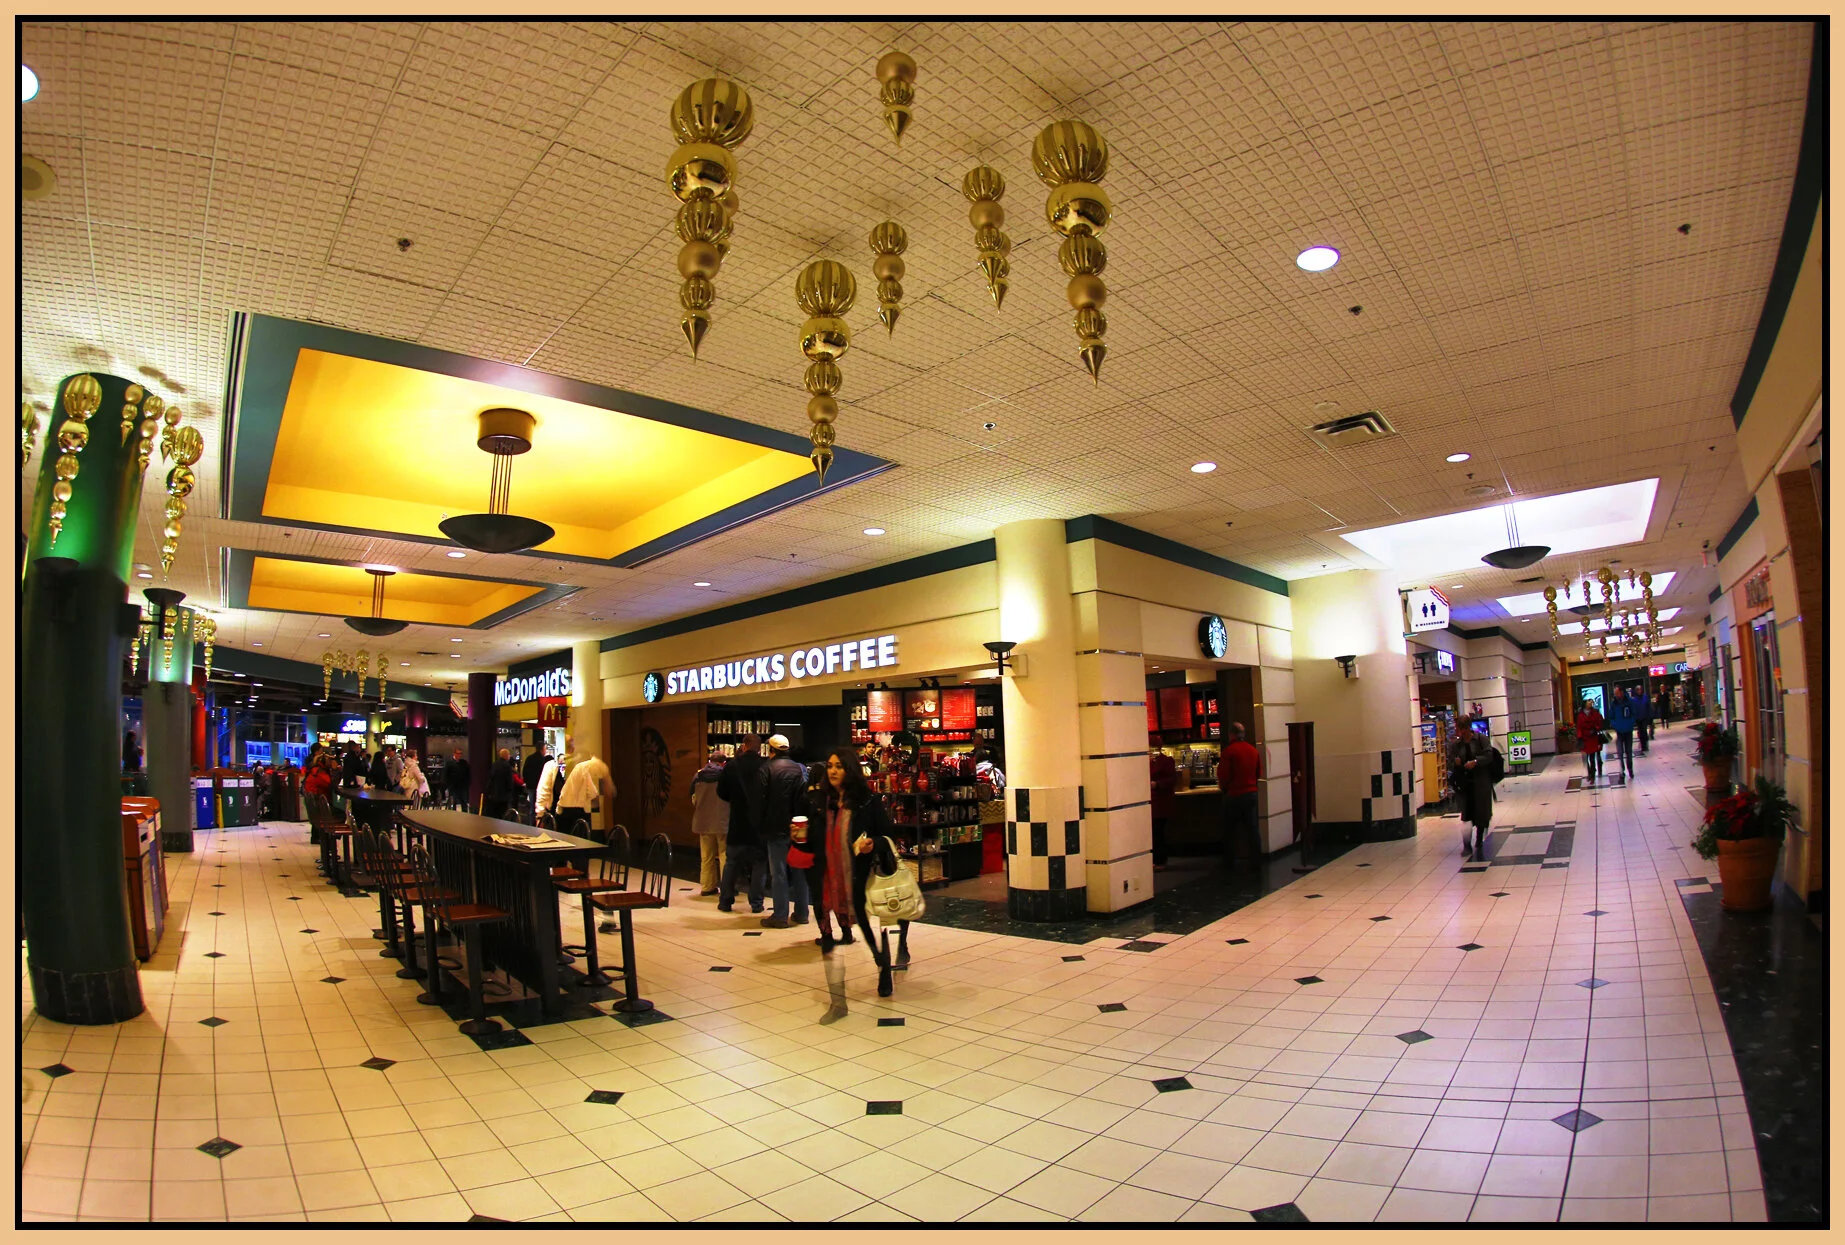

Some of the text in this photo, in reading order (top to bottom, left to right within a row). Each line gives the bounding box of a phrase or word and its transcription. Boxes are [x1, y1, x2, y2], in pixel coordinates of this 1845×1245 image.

[494, 667, 570, 706] McDonald's
[667, 634, 897, 696] STARBUCKS COFFEE
